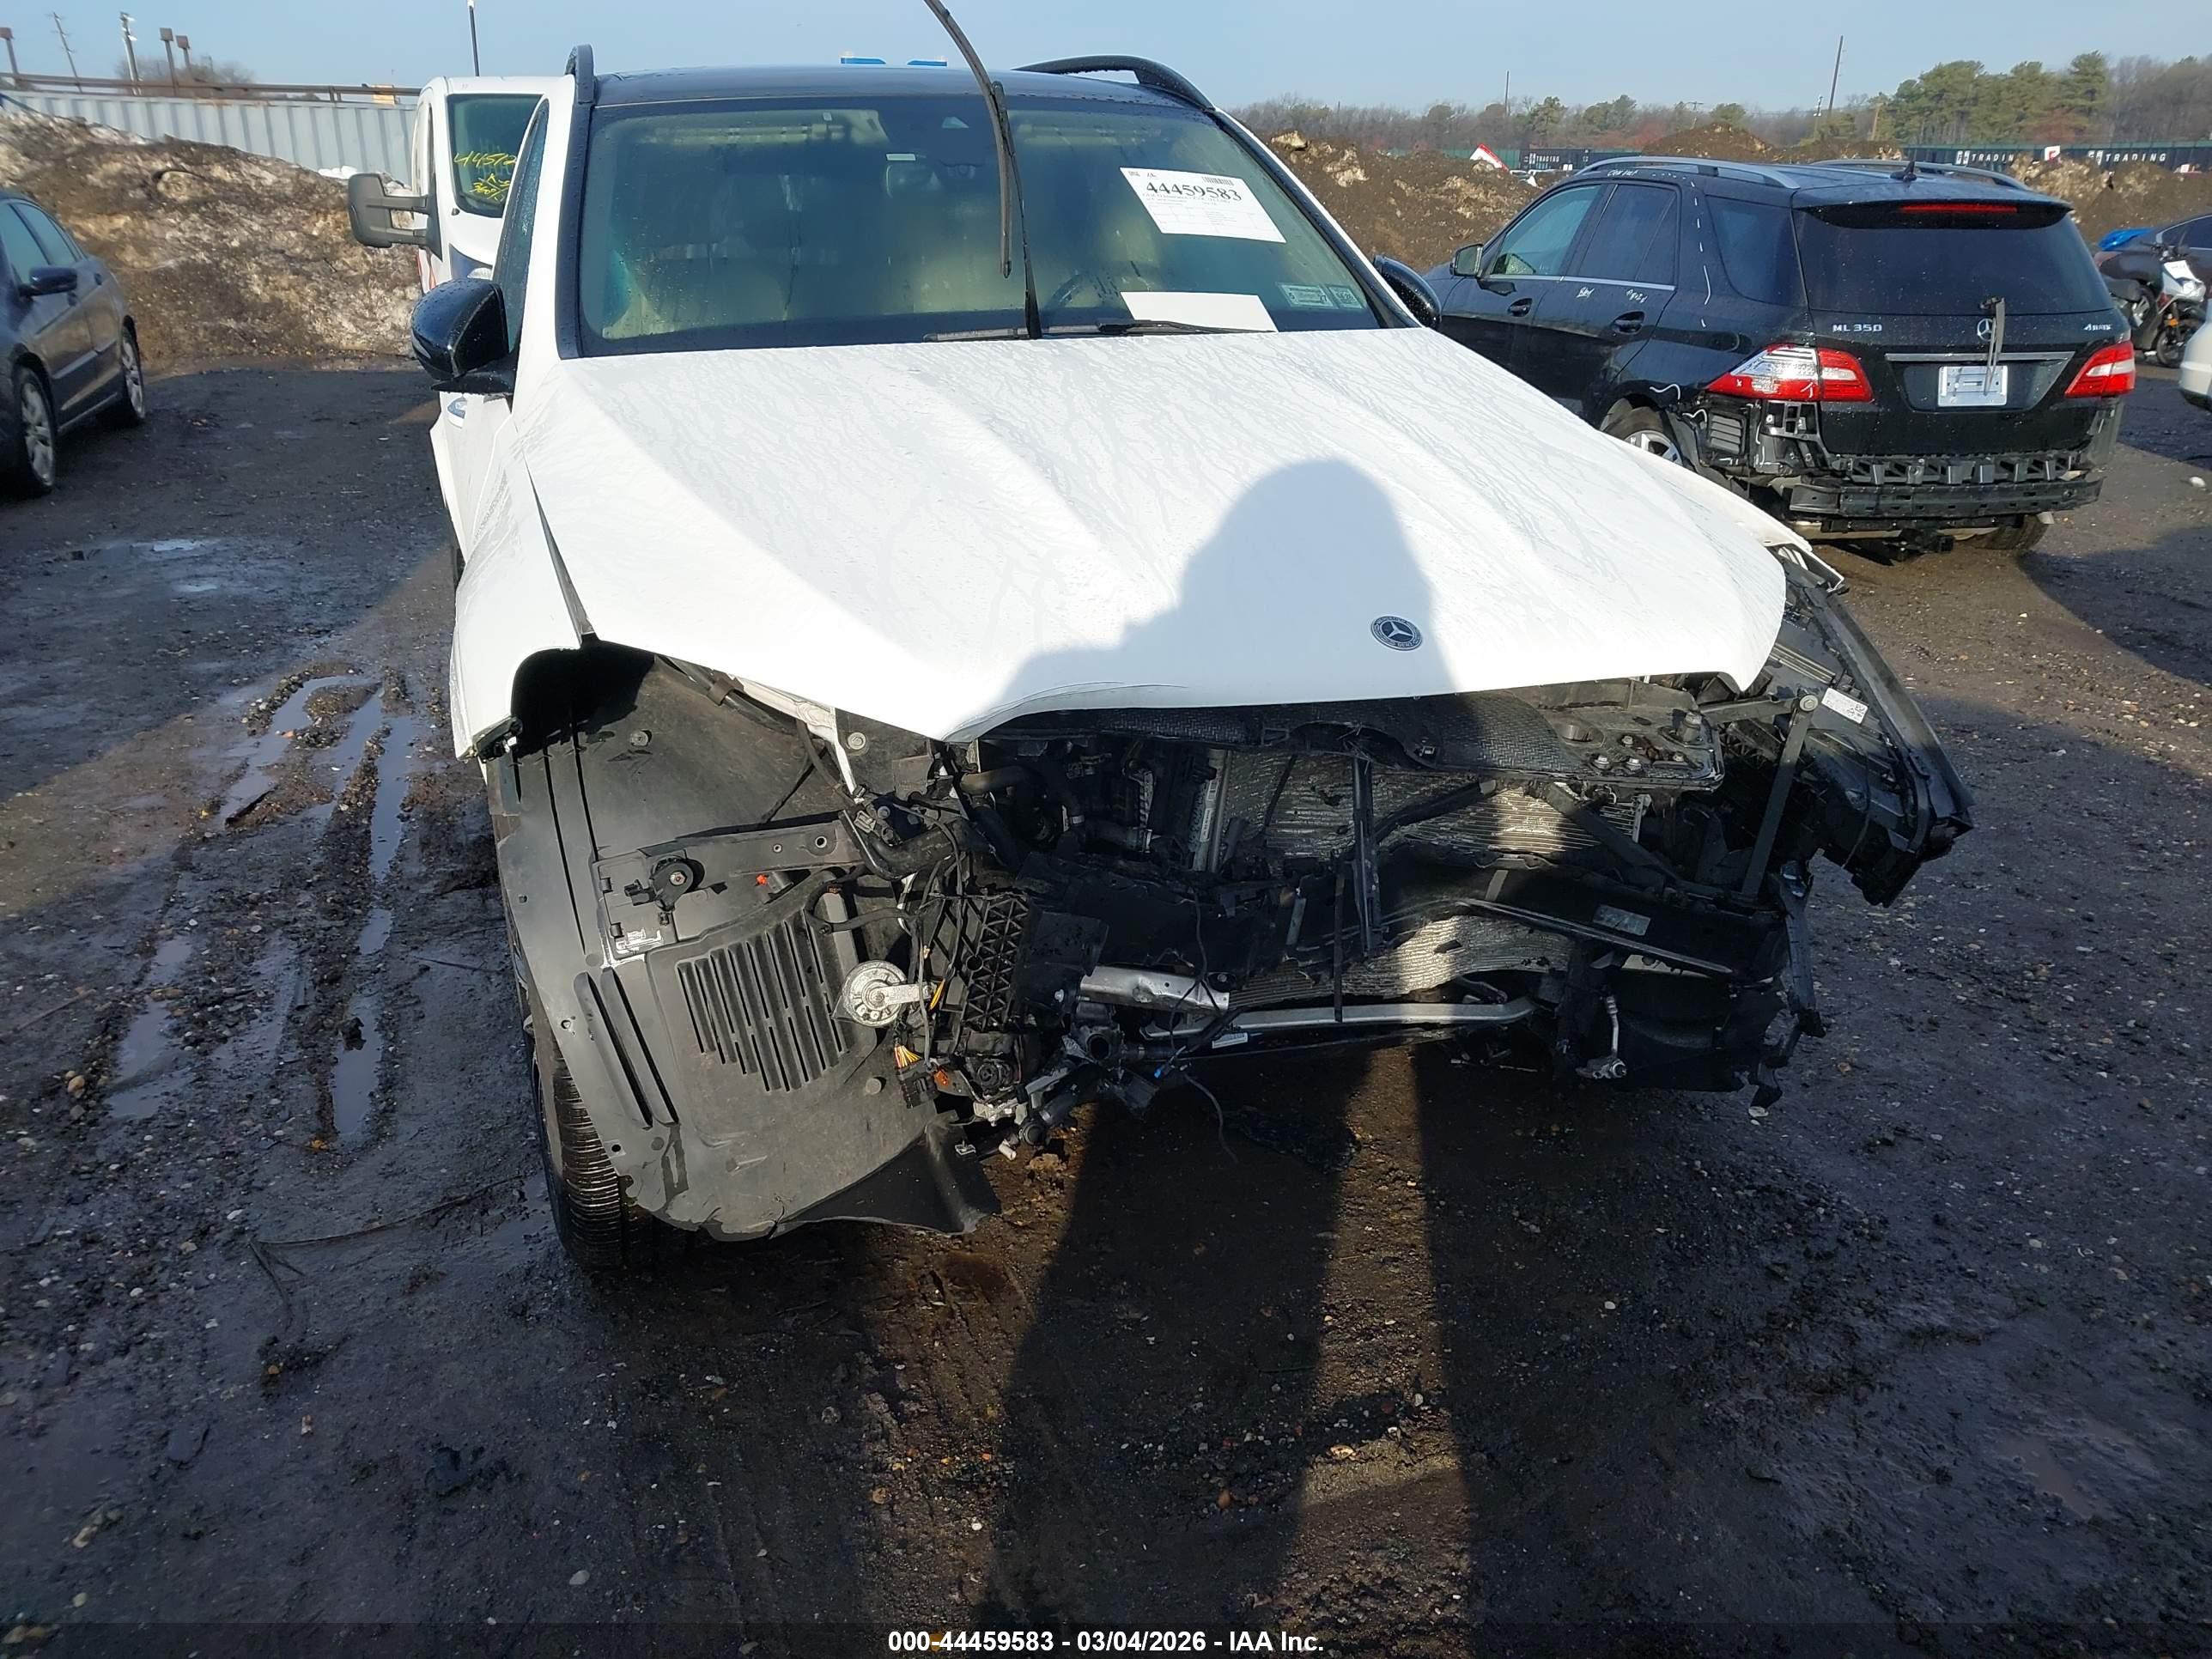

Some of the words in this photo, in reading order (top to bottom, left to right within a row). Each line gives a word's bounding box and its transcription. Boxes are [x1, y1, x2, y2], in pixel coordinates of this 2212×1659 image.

[2105, 153, 2166, 162] TRADING
[1146, 182, 1243, 202] 44459583
[1832, 324, 1851, 332] ML
[1853, 324, 1883, 332] 350
